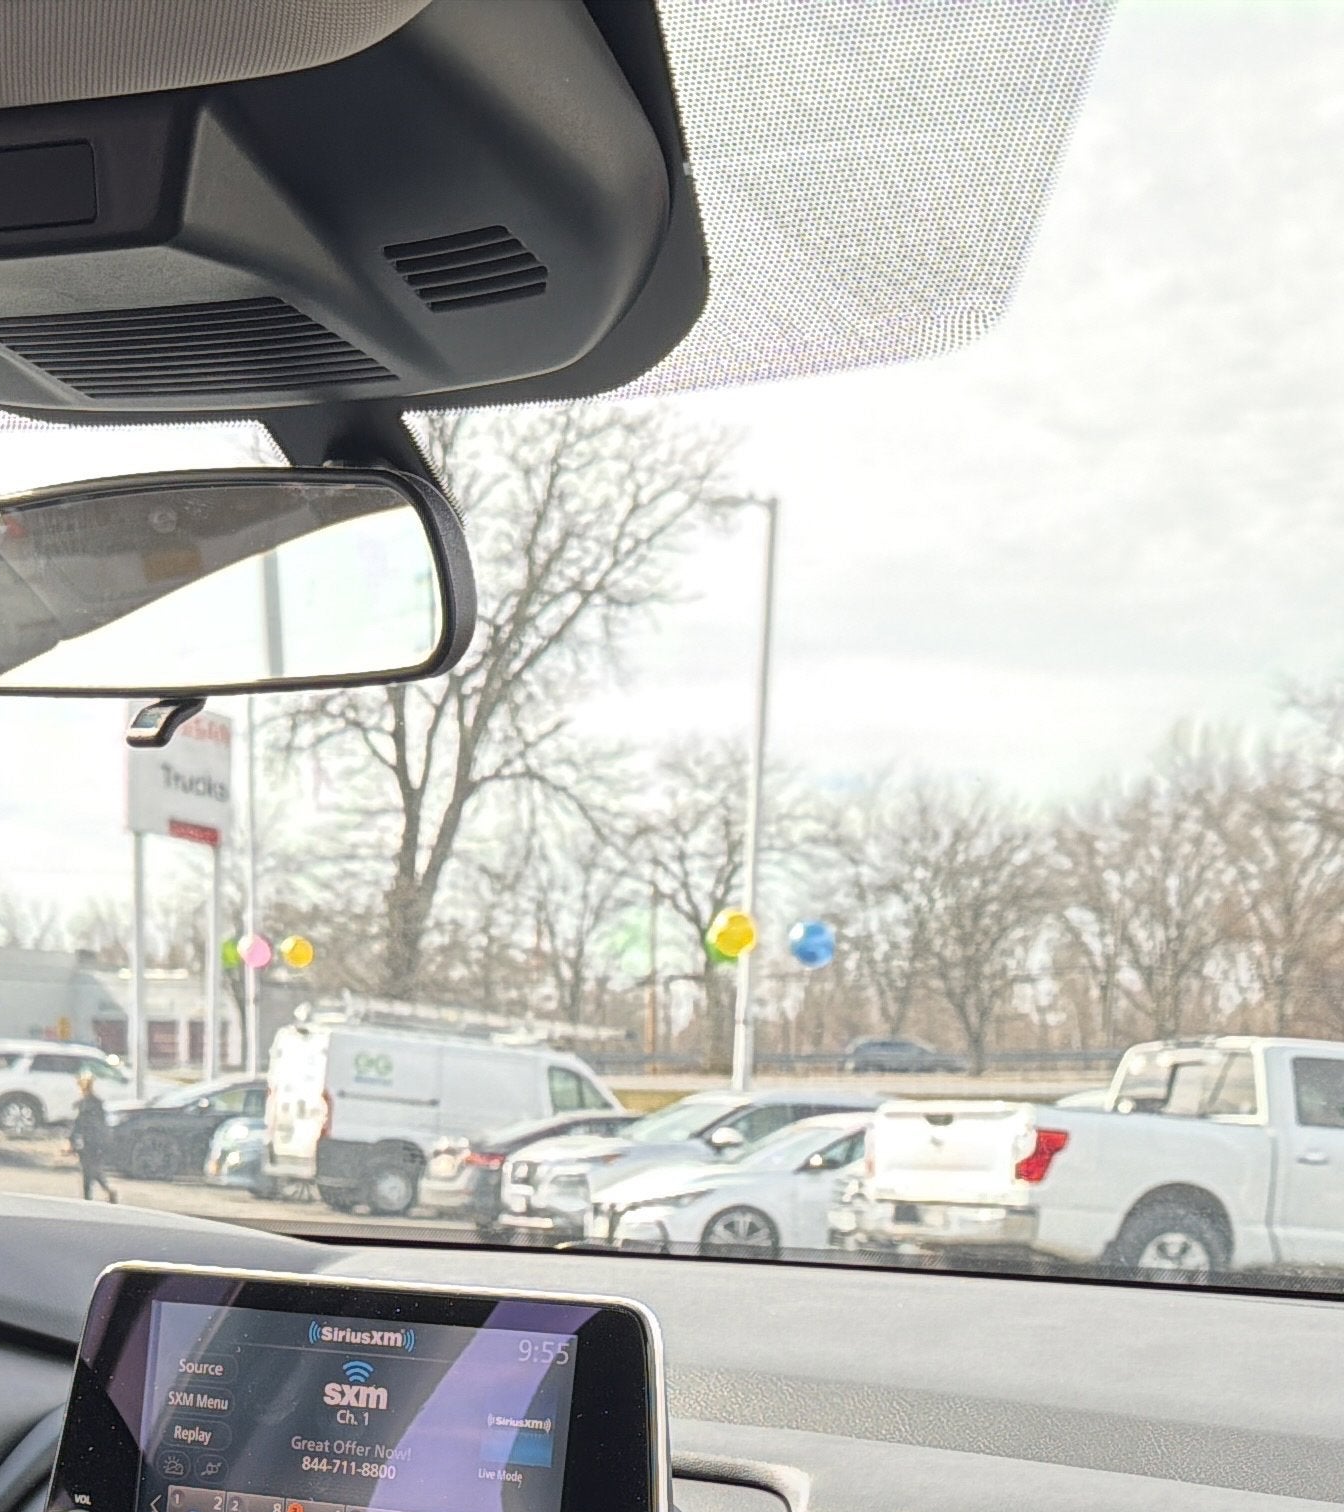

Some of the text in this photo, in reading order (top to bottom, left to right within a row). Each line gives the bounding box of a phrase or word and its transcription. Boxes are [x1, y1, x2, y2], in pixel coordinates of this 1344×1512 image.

[517, 1338, 571, 1365] 9:55
[178, 1358, 224, 1376] Source
[168, 1391, 229, 1411] SXM Menu
[336, 1409, 369, 1426] Ch. 1
[173, 1425, 212, 1445] Replay
[291, 1435, 412, 1461] Great Offer Now!
[301, 1455, 396, 1480] 844-711-8800
[478, 1467, 523, 1483] Live Mode
[74, 1494, 92, 1506] VOL
[213, 1495, 223, 1511] 2
[231, 1500, 239, 1512] 2
